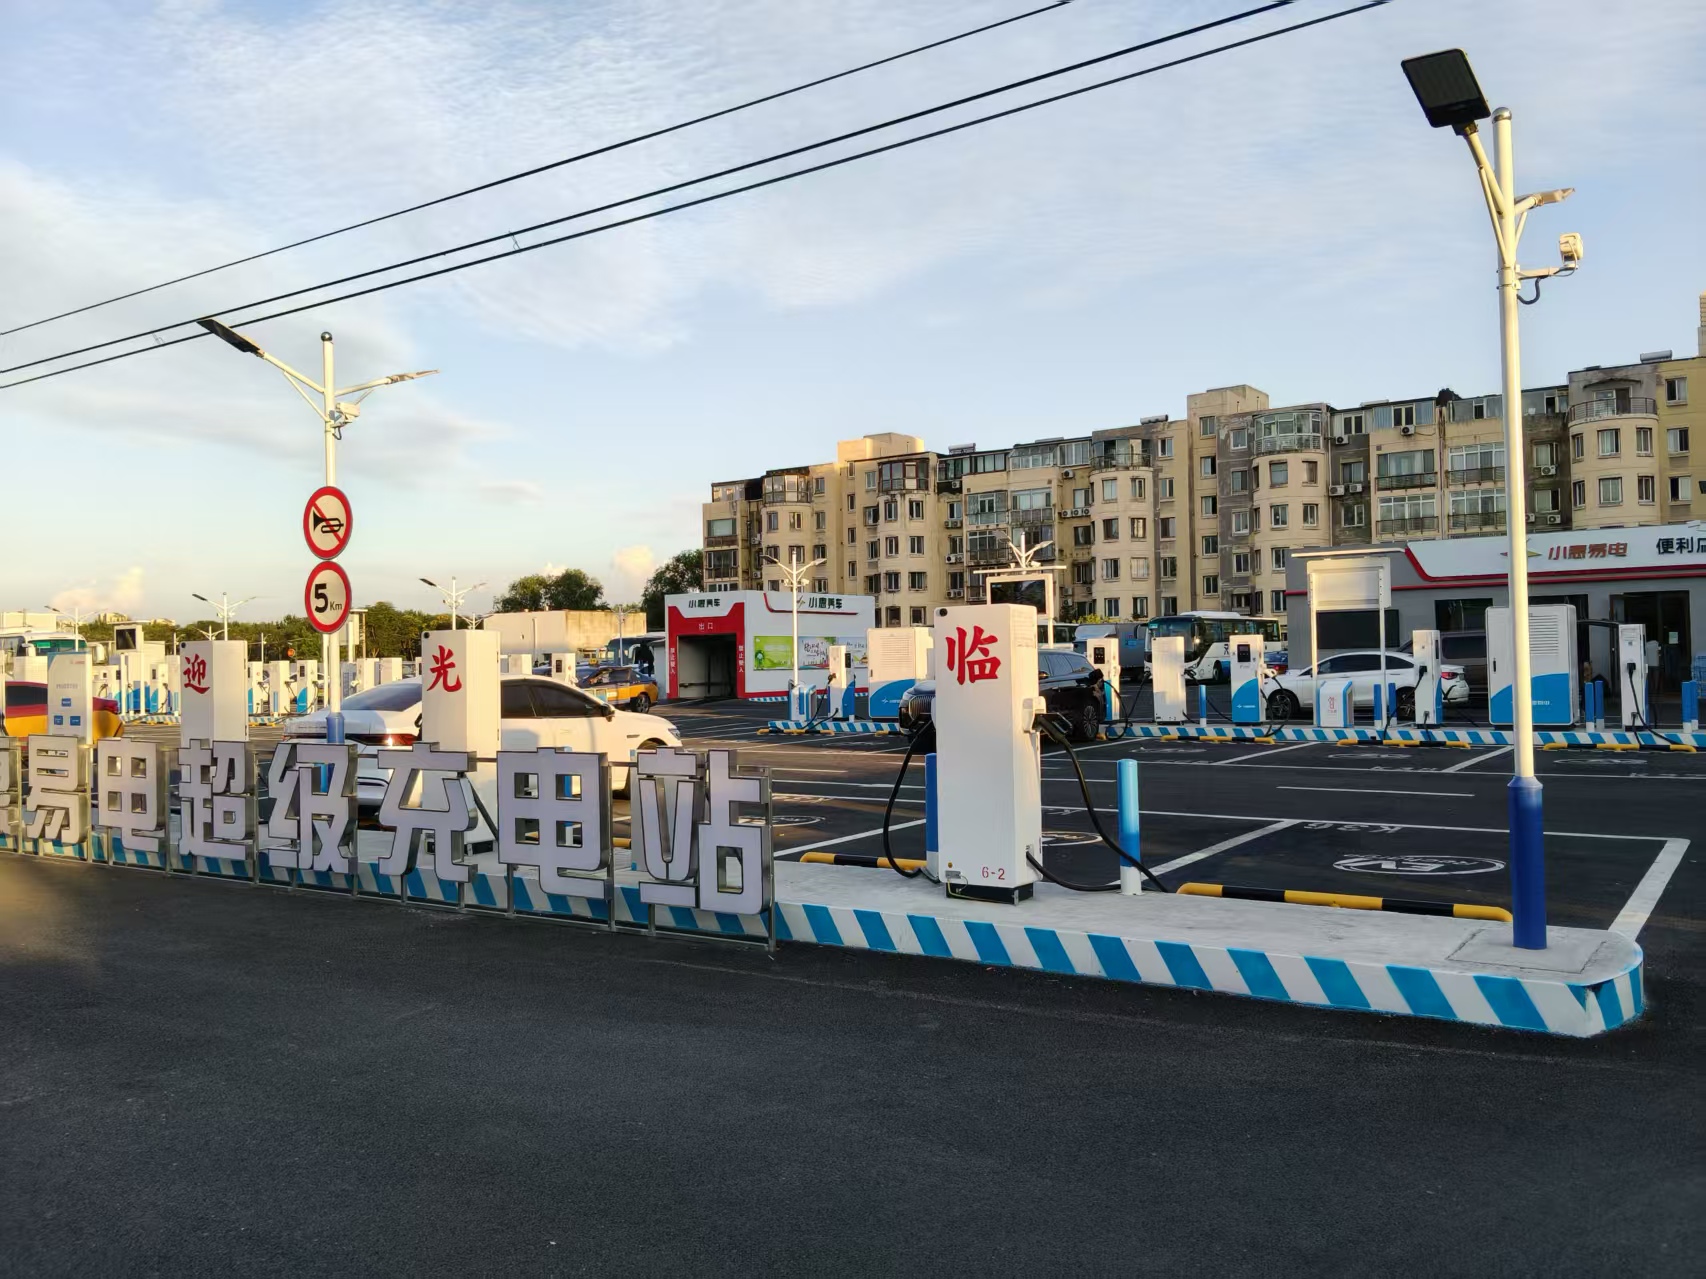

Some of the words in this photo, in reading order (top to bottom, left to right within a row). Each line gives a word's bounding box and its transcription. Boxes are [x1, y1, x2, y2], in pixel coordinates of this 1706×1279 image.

[1548, 543, 1628, 560] 小惠易电
[698, 622, 713, 630] 出口
[183, 653, 210, 694] 迎
[427, 645, 462, 692] 光
[945, 625, 1001, 685] 临
[0, 734, 771, 914] 易电超级充电站
[982, 866, 1005, 880] 6-2
